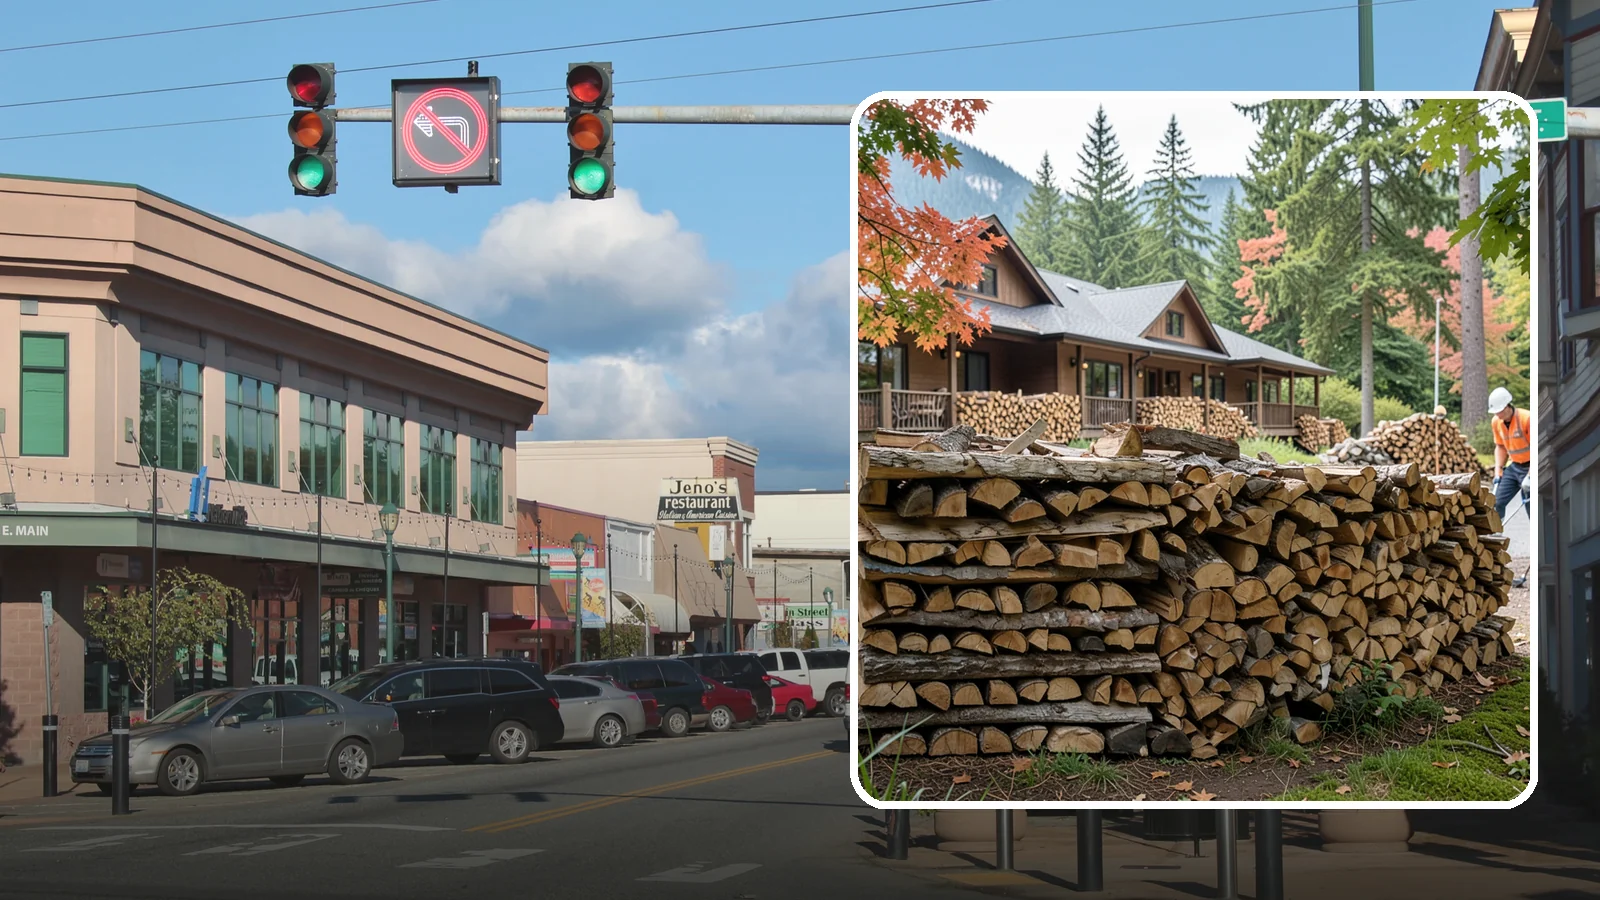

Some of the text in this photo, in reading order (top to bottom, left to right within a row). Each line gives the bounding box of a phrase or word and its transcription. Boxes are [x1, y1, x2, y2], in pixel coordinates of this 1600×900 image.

[670, 480, 727, 494] Jeno's
[665, 496, 731, 509] restaurant
[659, 510, 681, 519] Italian
[686, 509, 714, 519] American
[715, 509, 737, 519] Cuisine
[2, 525, 49, 536] E. MAIN
[798, 607, 828, 617] Street
